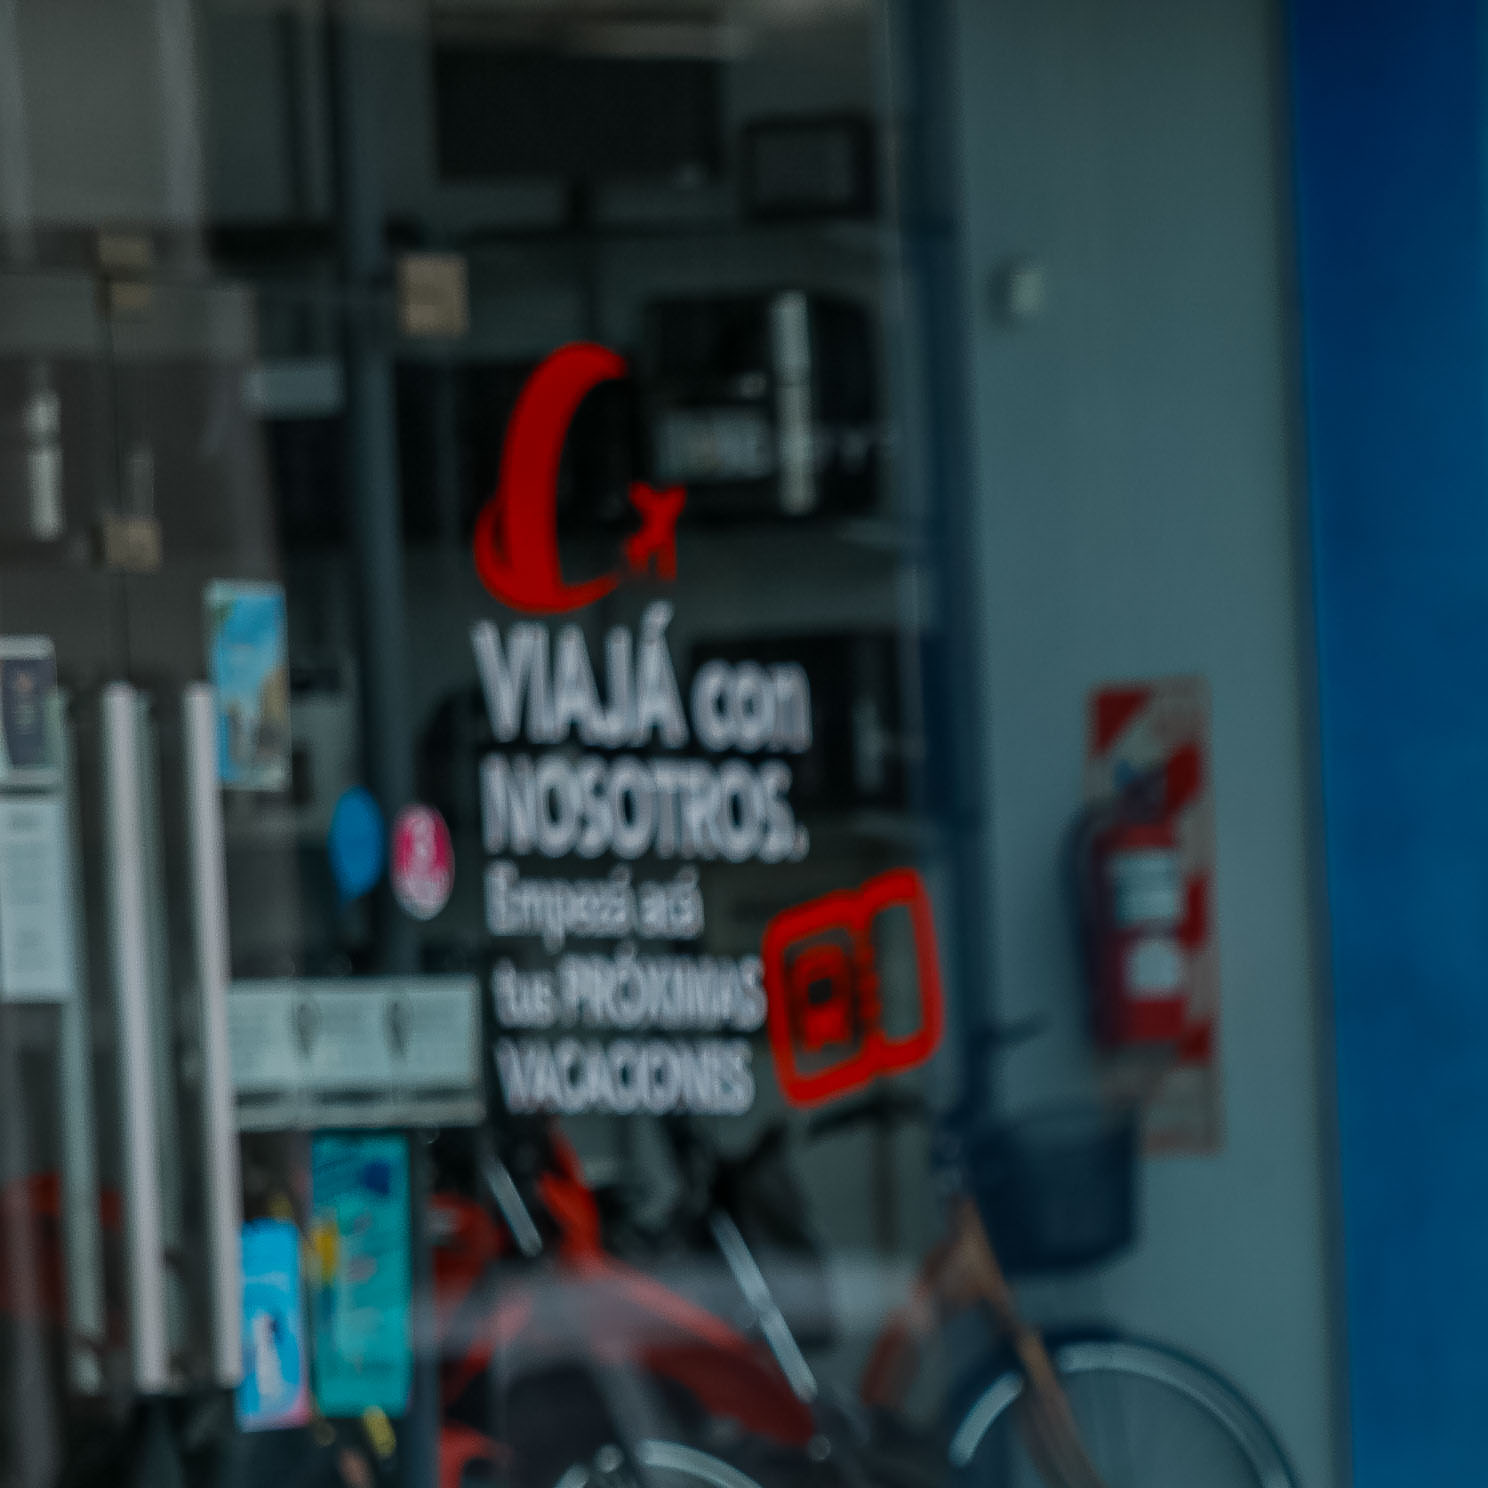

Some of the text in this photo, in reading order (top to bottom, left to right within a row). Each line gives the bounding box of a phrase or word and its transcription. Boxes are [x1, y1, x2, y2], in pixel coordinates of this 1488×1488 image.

[470, 600, 812, 754] VIAJÁ con
[479, 752, 810, 864] NOSOTROS.
[493, 942, 768, 1032] tus PRÓXIMAS
[497, 1036, 755, 1116] VACACIONES
